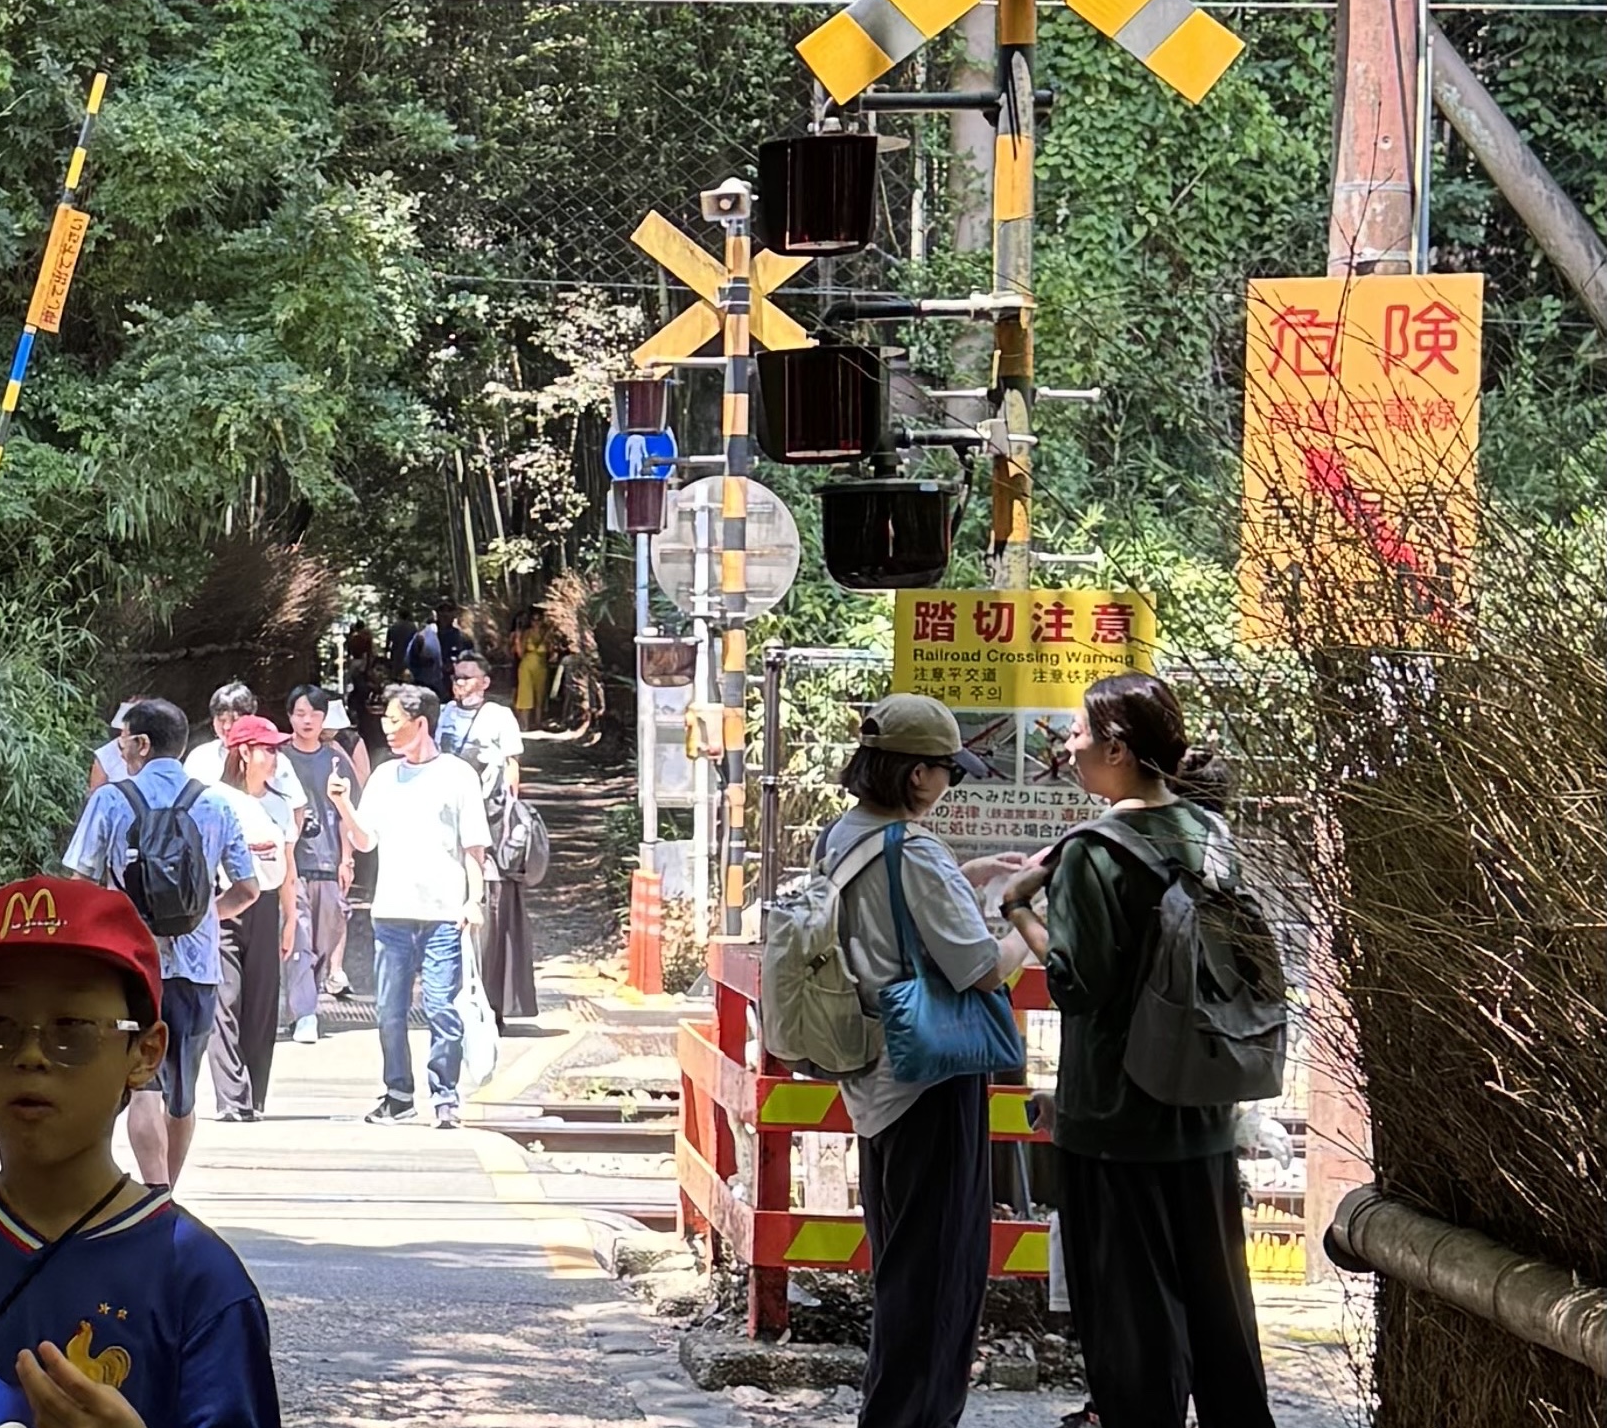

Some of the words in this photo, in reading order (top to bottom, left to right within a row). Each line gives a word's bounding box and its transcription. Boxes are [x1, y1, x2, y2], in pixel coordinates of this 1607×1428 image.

[1270, 301, 1461, 377] 危険
[913, 601, 1135, 643] 踏切注意
[913, 648, 981, 662] Railroad
[987, 649, 1060, 666] Crossing
[970, 686, 1002, 702] 주의
